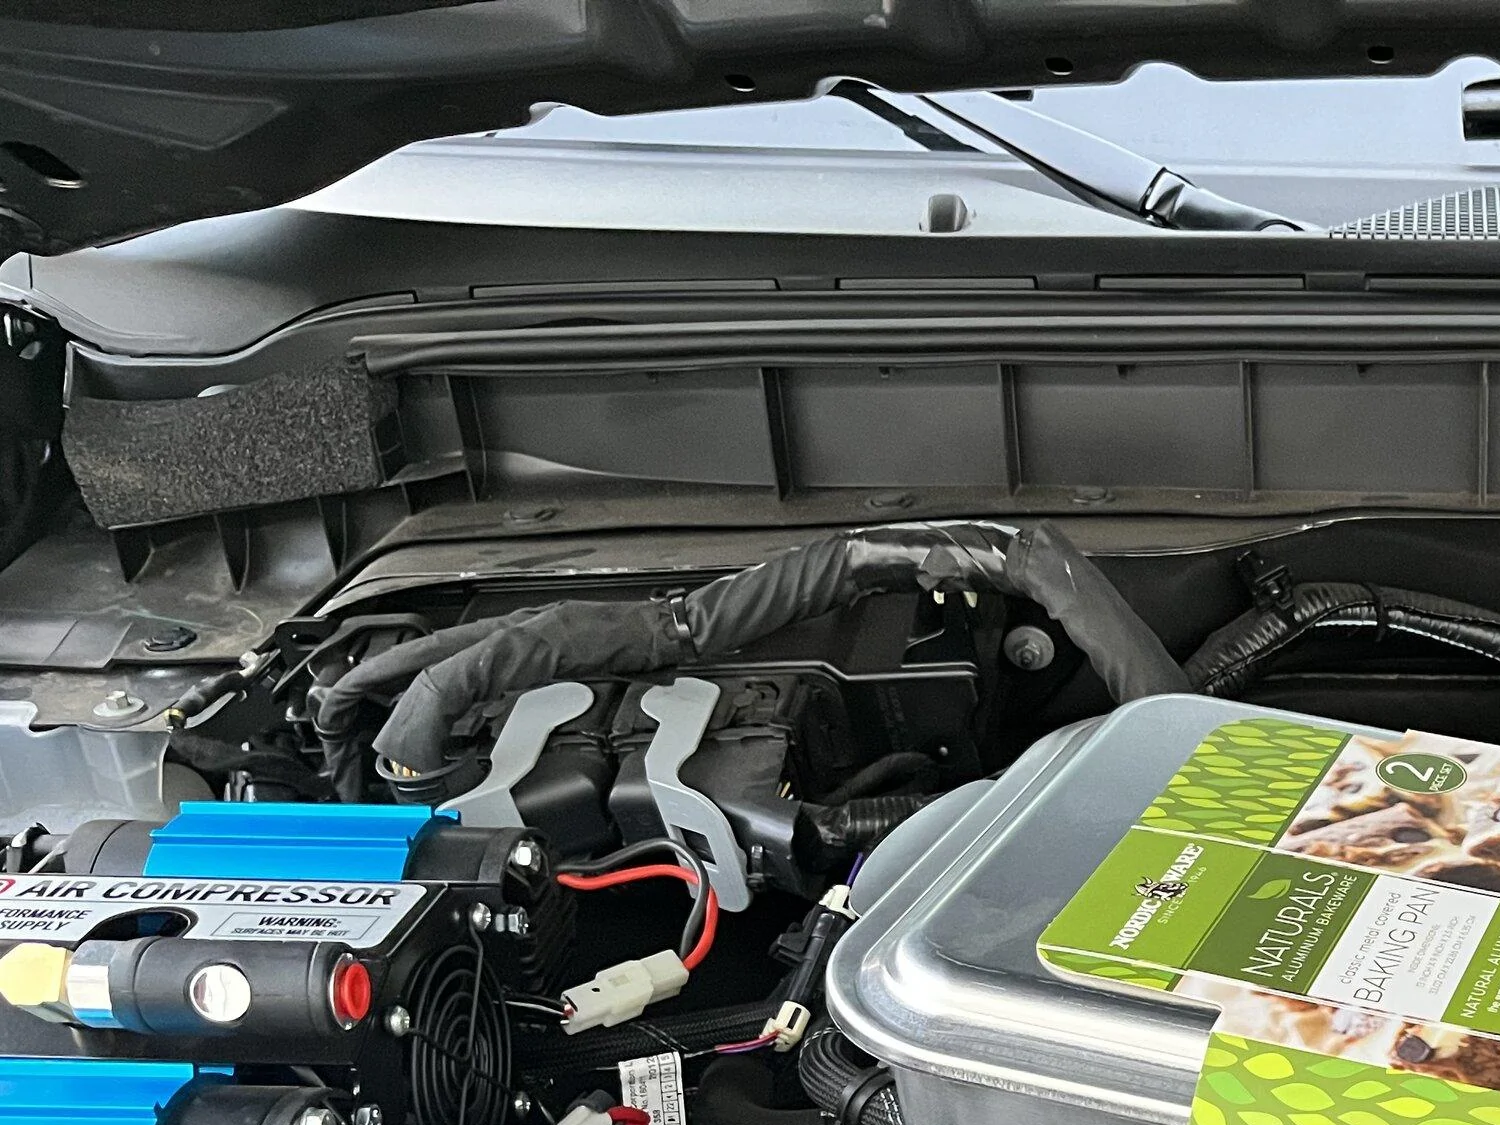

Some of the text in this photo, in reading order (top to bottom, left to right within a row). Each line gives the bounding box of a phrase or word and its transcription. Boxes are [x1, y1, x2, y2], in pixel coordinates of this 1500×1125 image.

[1385, 761, 1434, 782] 2
[0, 920, 71, 931] SUPPLY
[14, 880, 402, 907] AIR COMPRESSOR
[257, 915, 343, 929] WARNING:
[1108, 843, 1204, 950] NORDIC WARE
[1239, 870, 1335, 977] NATURALS
[1280, 873, 1358, 982] ALUMINUM BAKEWARE
[1340, 892, 1401, 984] classic metal covered
[1352, 887, 1440, 1003] BAKING PAN
[1459, 967, 1497, 1018] NATURAL
